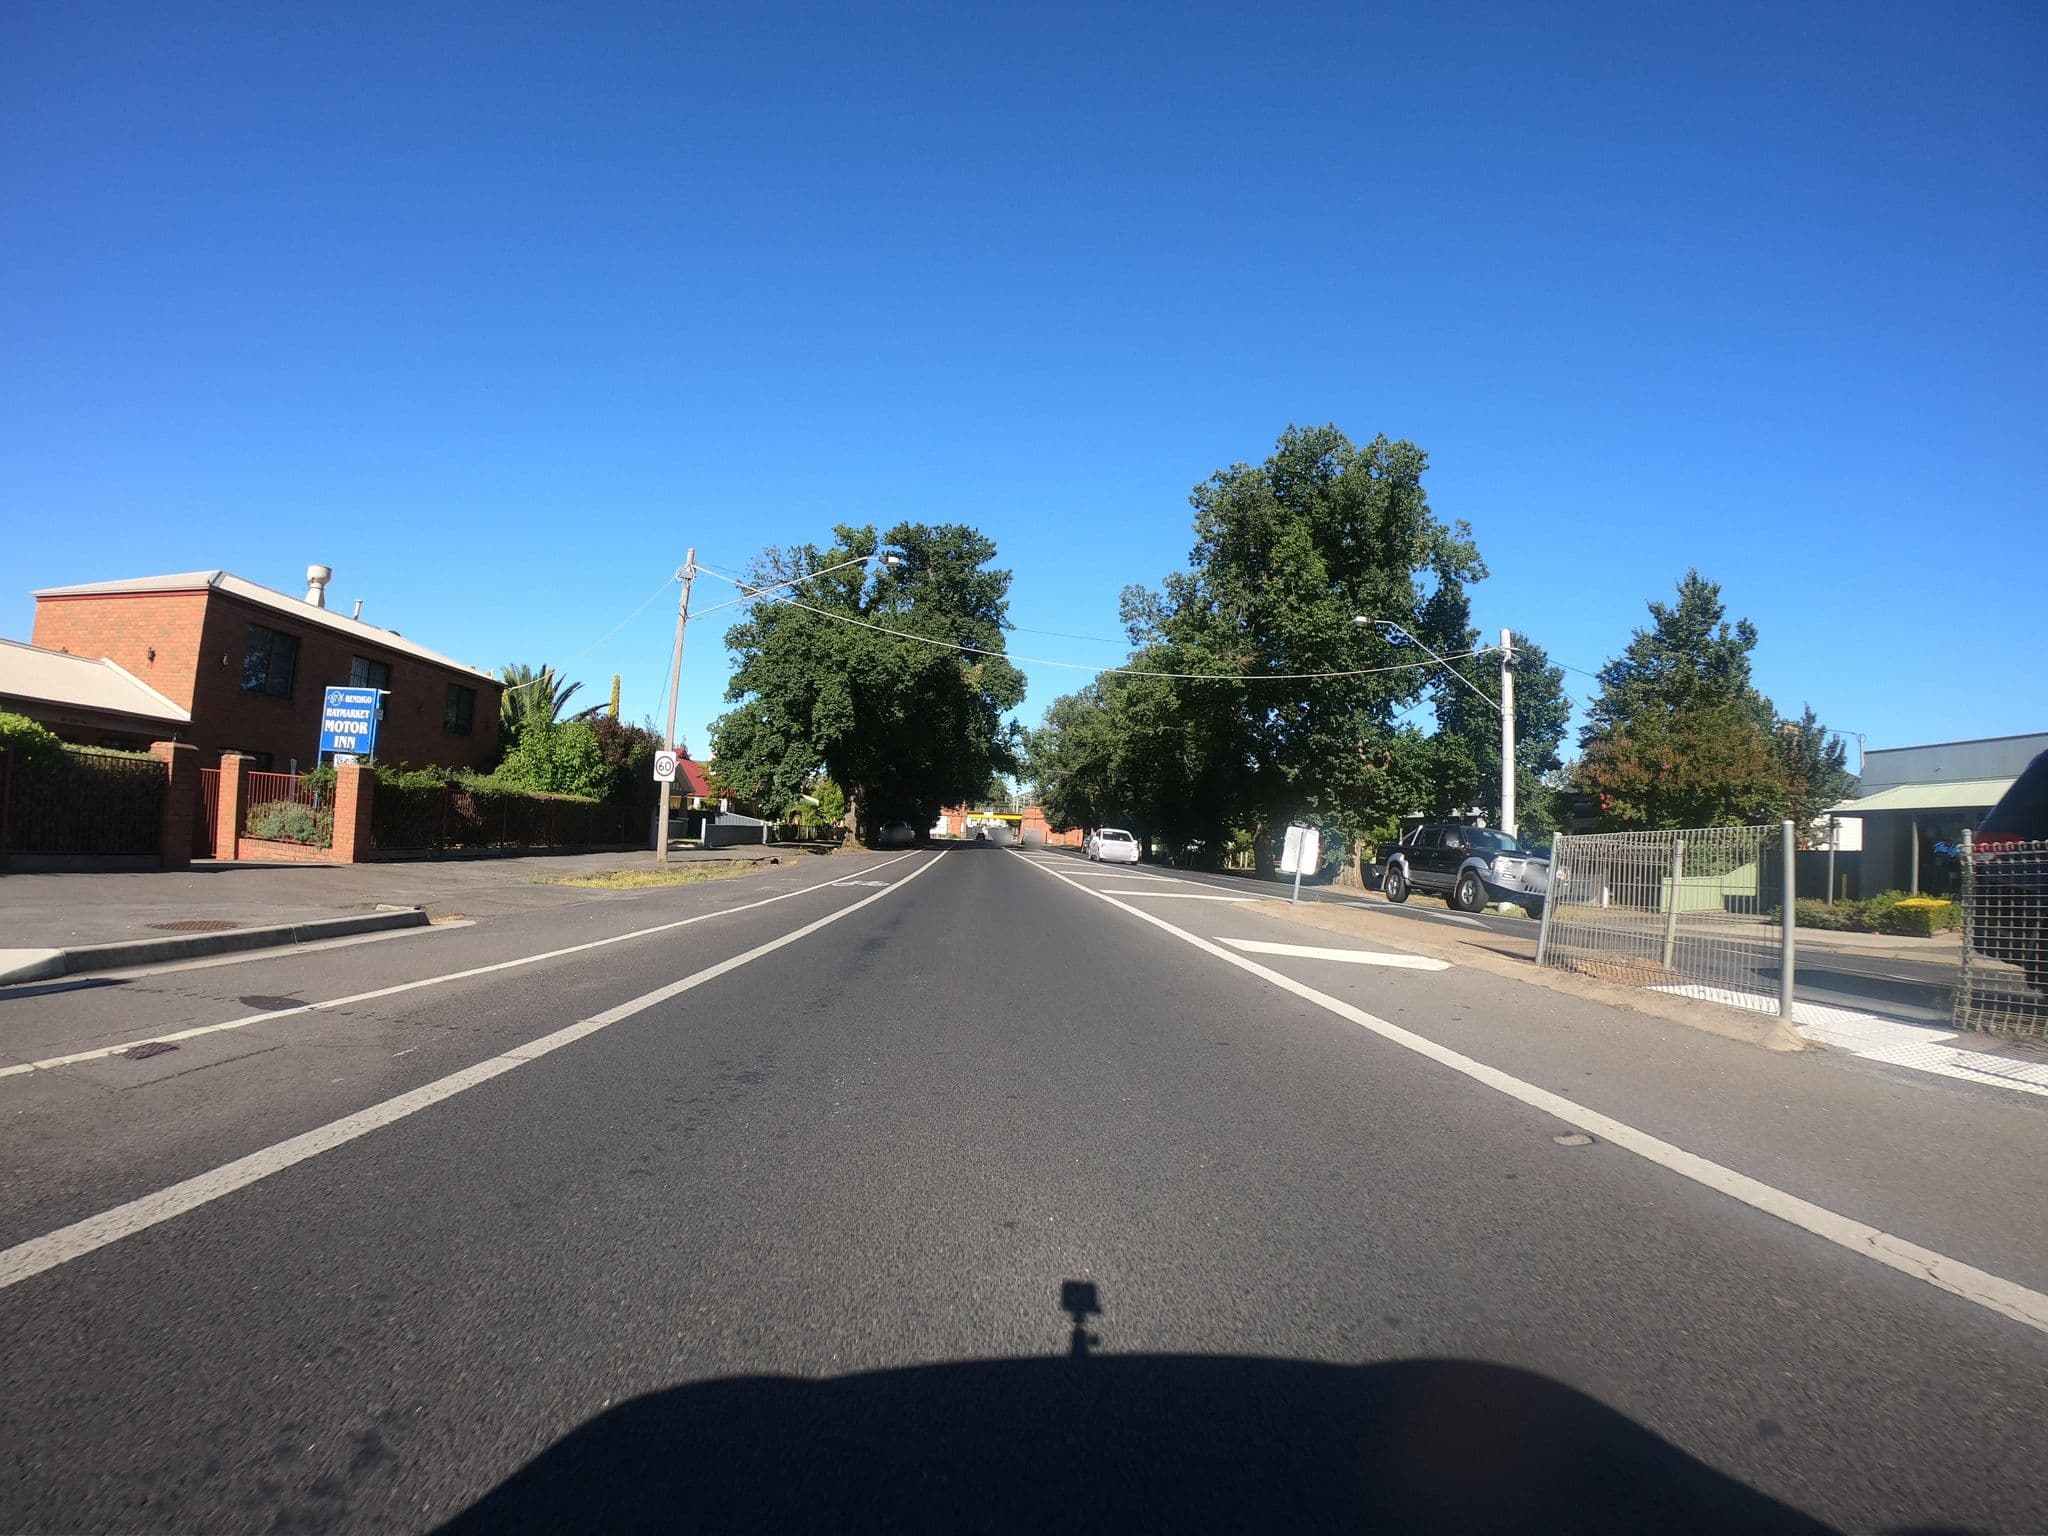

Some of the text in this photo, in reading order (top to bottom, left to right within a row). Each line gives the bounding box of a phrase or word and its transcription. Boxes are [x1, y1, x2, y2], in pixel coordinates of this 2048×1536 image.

[326, 708, 370, 719] HAYMARKET
[324, 720, 368, 734] MOTOR
[333, 735, 356, 749] INN
[658, 761, 672, 772] 60
